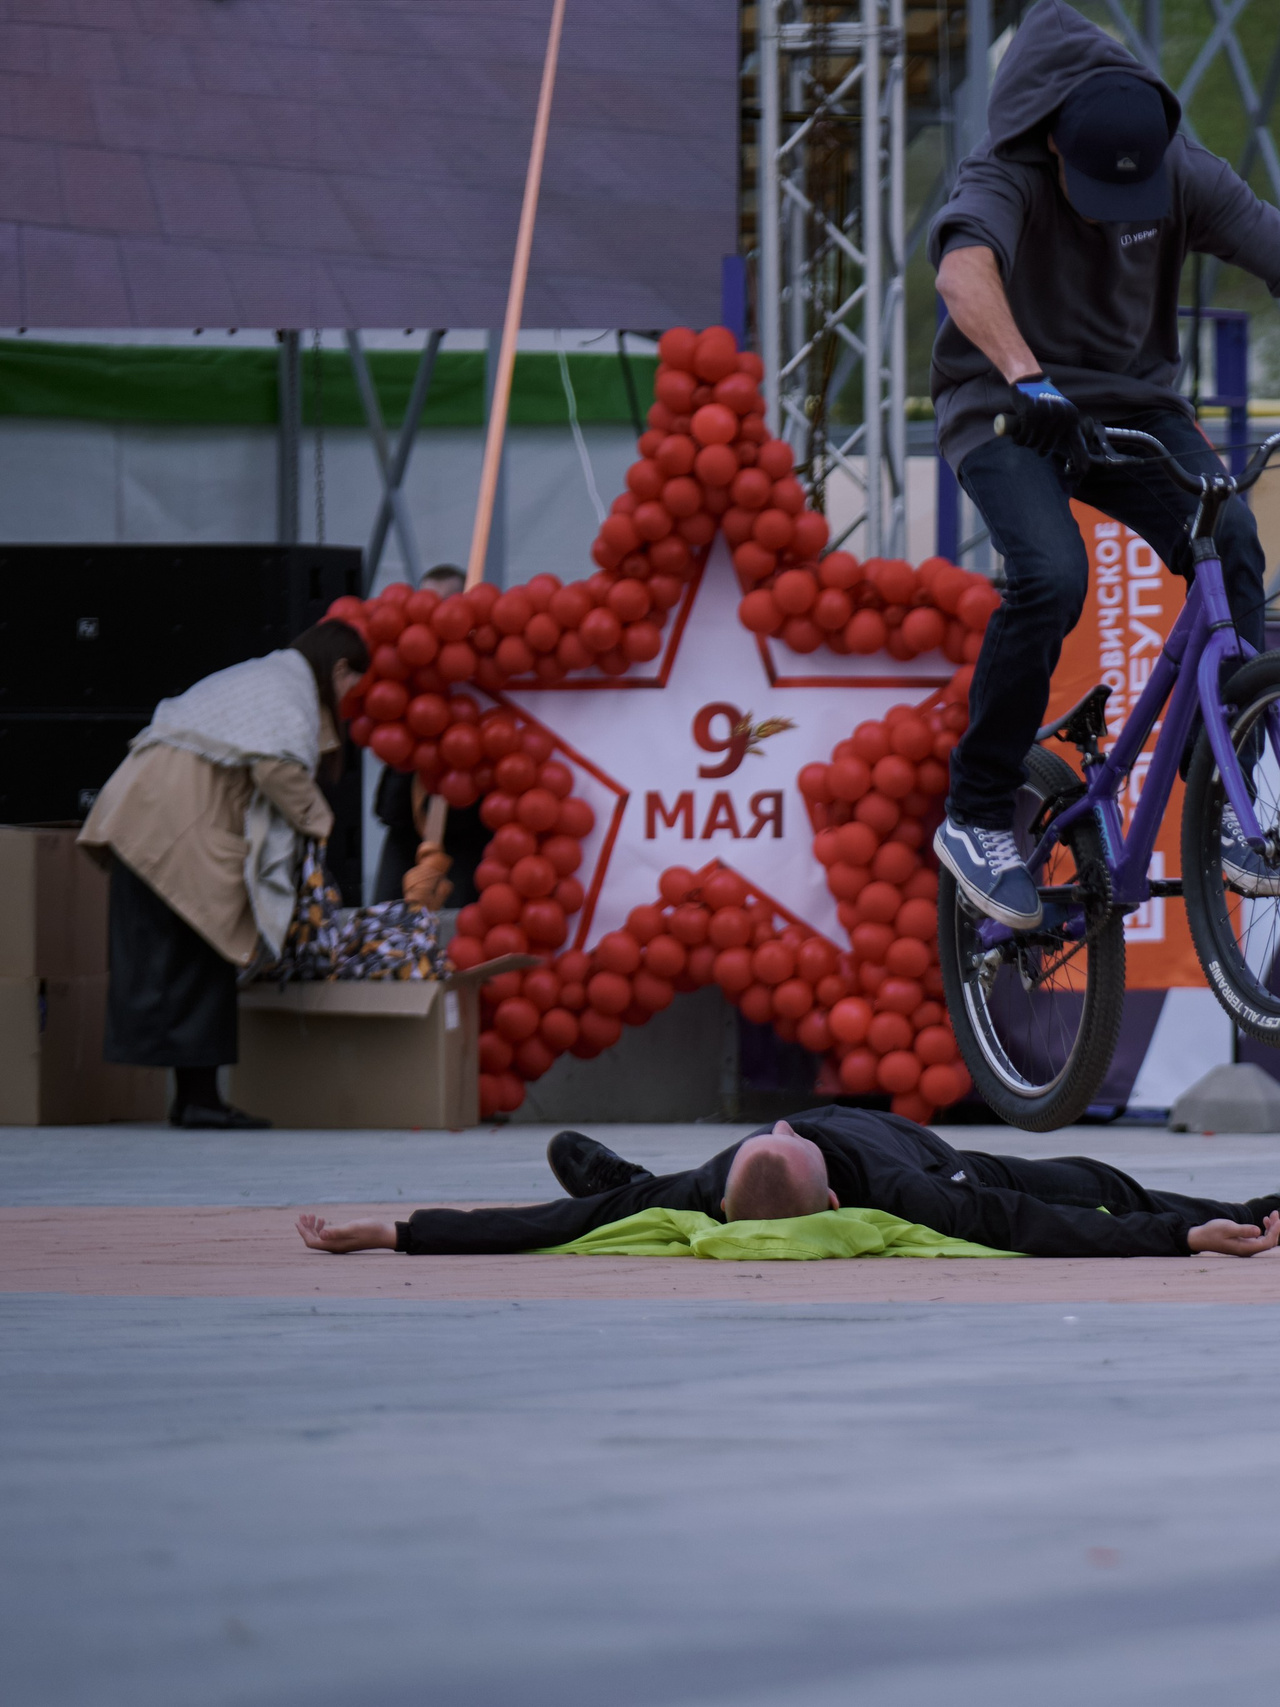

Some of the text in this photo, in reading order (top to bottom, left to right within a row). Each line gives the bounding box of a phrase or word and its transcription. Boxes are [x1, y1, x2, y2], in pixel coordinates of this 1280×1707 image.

[691, 701, 752, 780] 9
[644, 789, 784, 840] МАЯ
[1208, 960, 1244, 1013] TERRAINS
[1242, 1006, 1260, 1023] ALL
